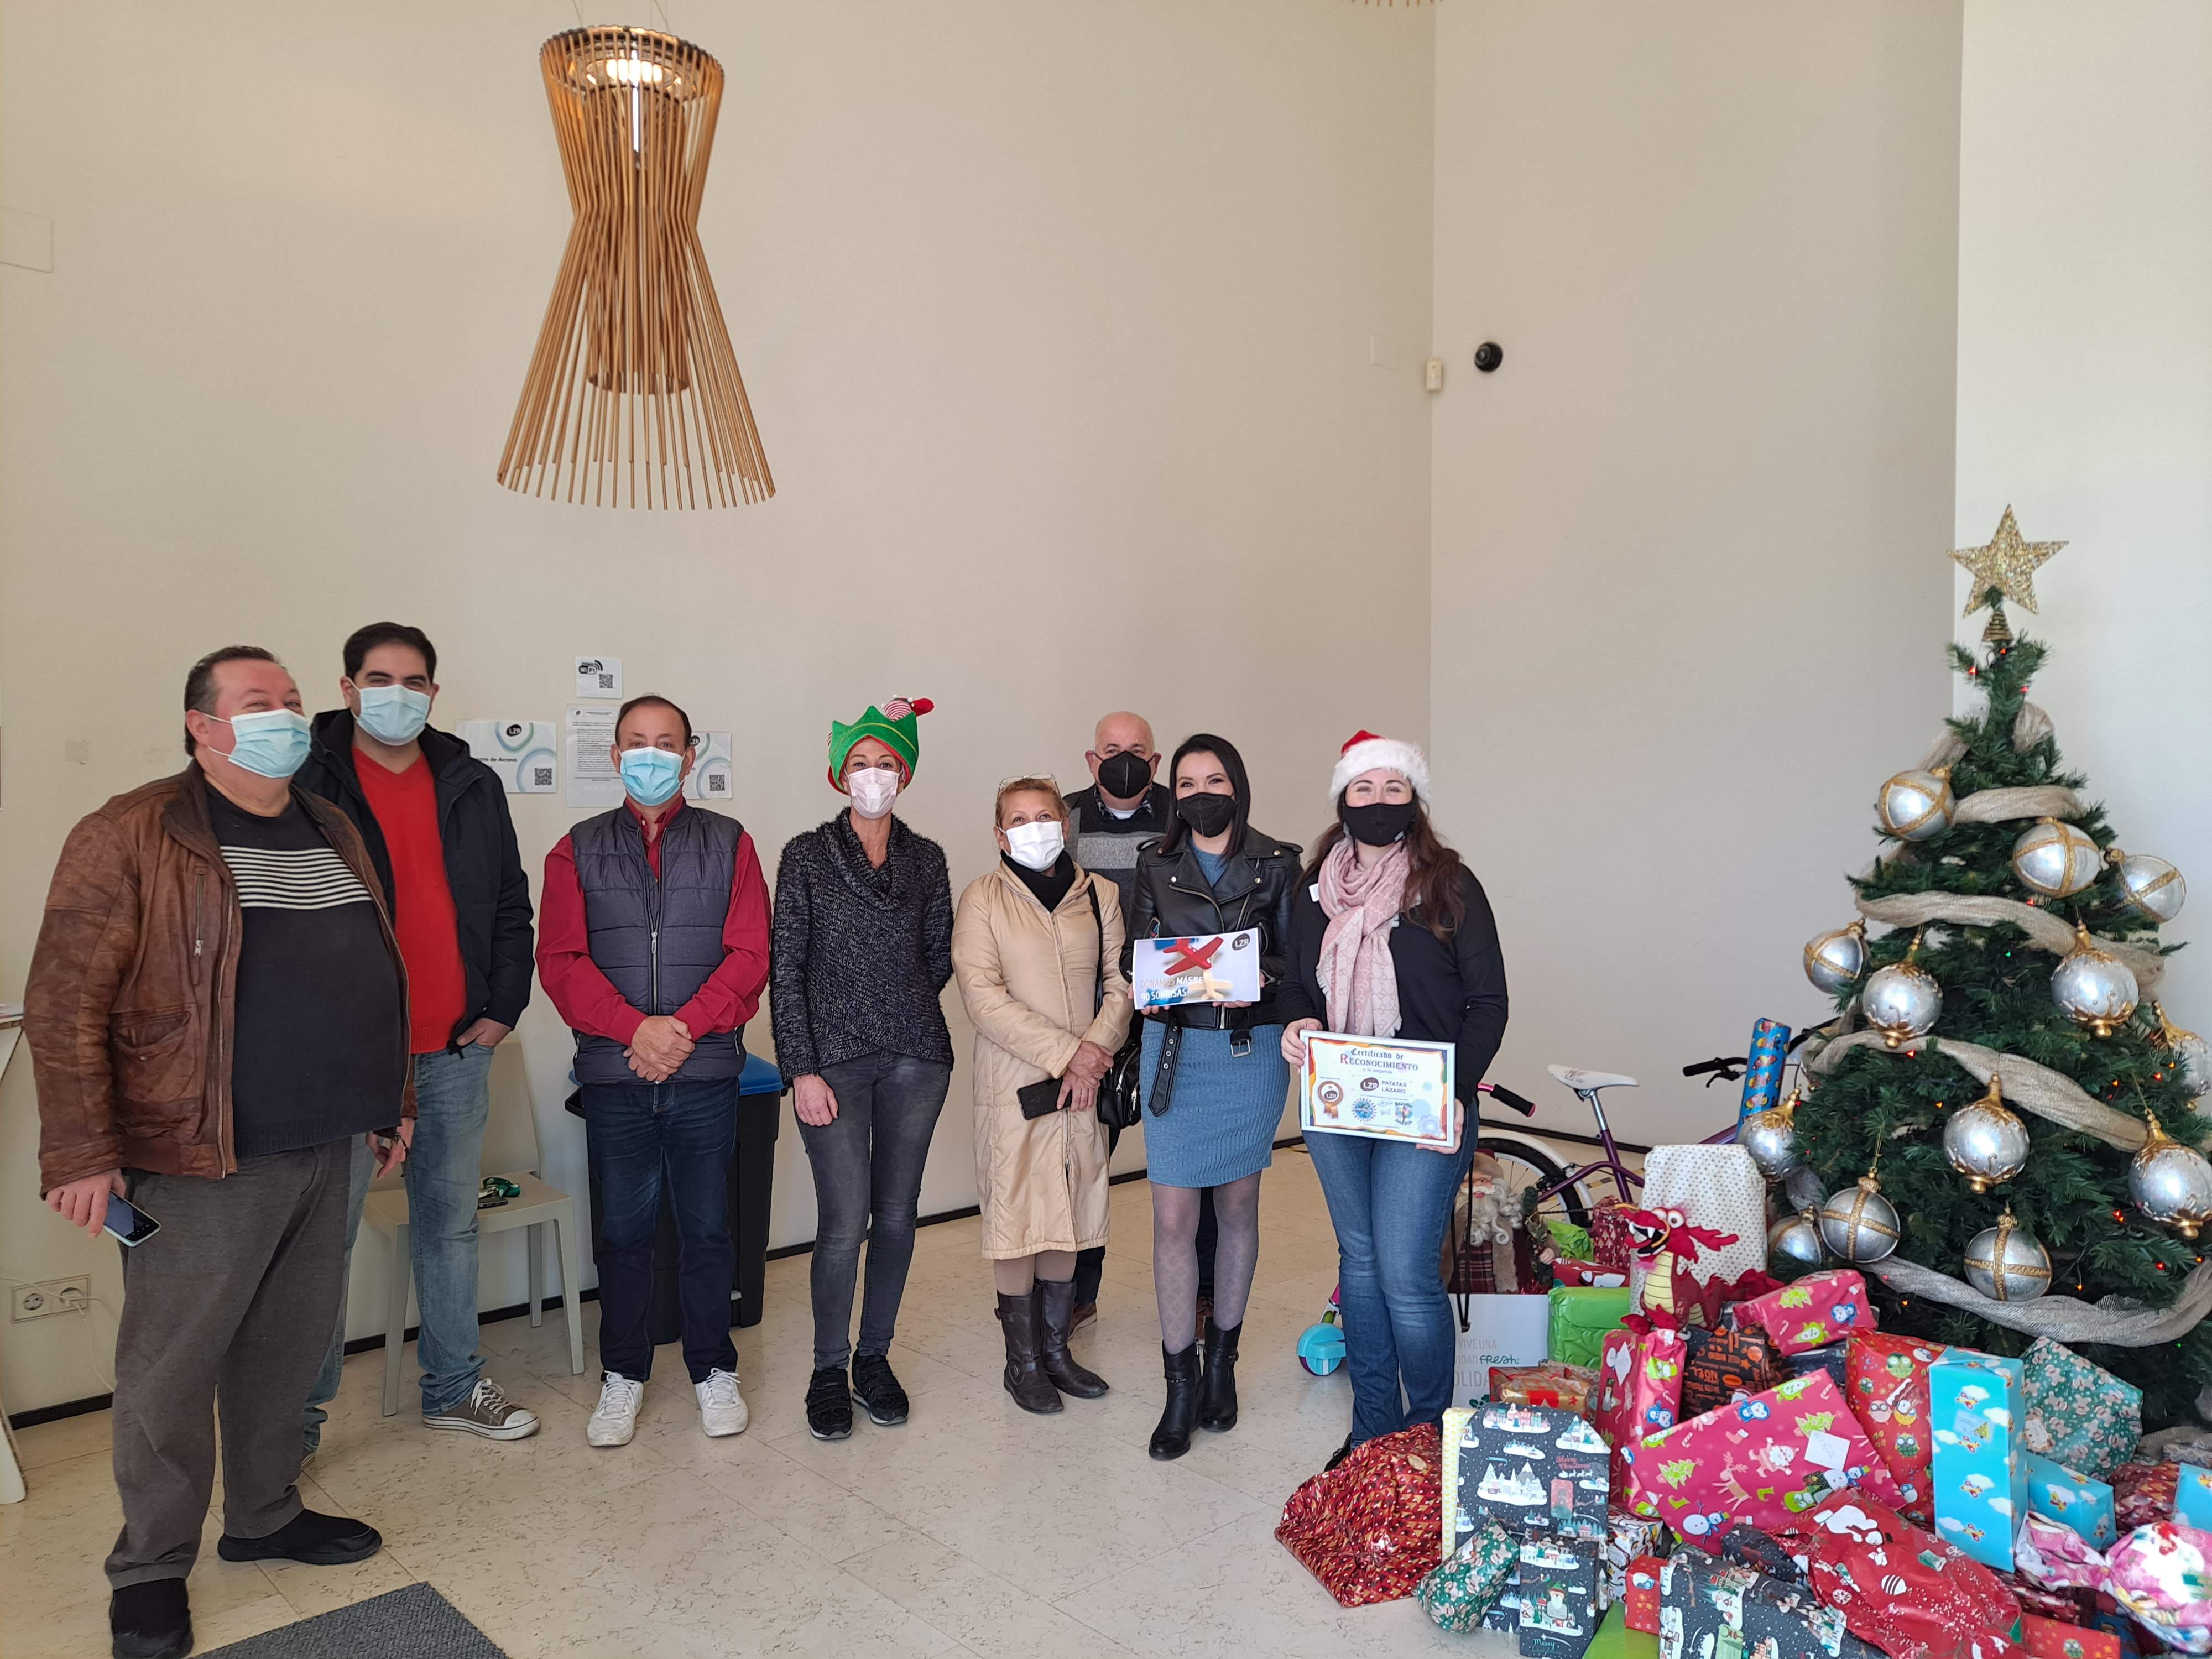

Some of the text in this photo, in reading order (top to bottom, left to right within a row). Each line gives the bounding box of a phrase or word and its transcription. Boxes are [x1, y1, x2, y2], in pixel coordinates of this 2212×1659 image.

[1235, 938, 1249, 948] LZR
[1140, 978, 1175, 988] DONAMOS
[1176, 975, 1192, 985] MÁS
[1141, 988, 1187, 1001] 90 SONRISAS
[1350, 1048, 1392, 1059] Certificado
[1340, 1053, 1418, 1071] RECONOCIMIENTO
[1363, 1081, 1378, 1089] LZR
[1457, 1339, 1497, 1349] VIVE UNA
